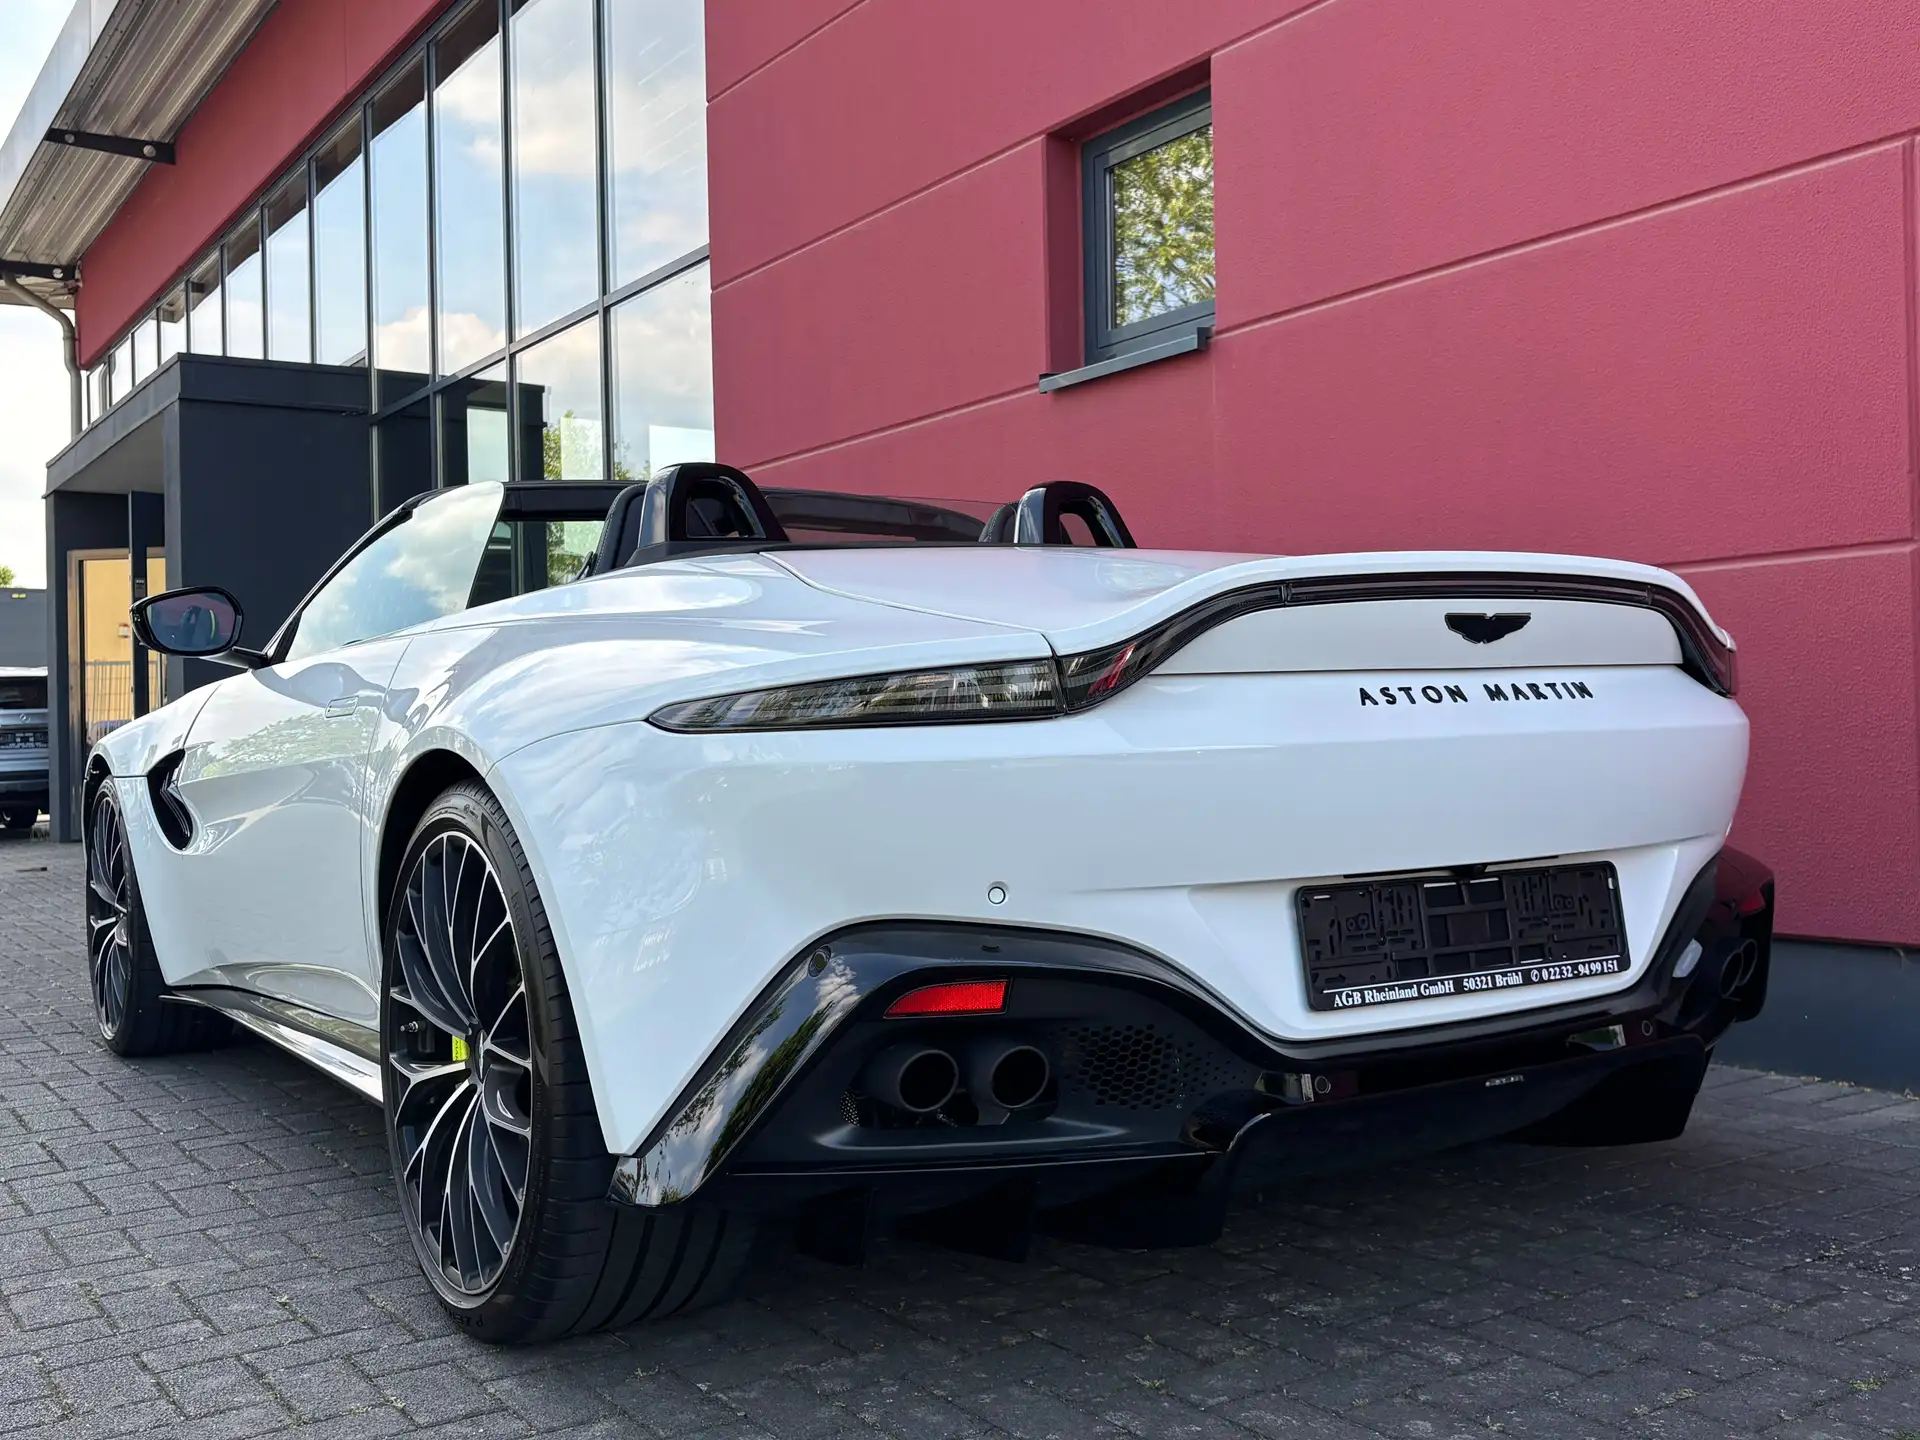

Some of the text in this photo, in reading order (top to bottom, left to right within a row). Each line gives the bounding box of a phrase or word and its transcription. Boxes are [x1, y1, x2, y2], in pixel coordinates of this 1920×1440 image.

[1359, 681, 1594, 706] ASTON MARTIN
[1333, 990, 1361, 1008] AGB
[1364, 987, 1418, 1003] Rheinland
[1420, 980, 1455, 996] GmbH
[1463, 976, 1493, 991] 50321
[1495, 972, 1523, 986] Brühl
